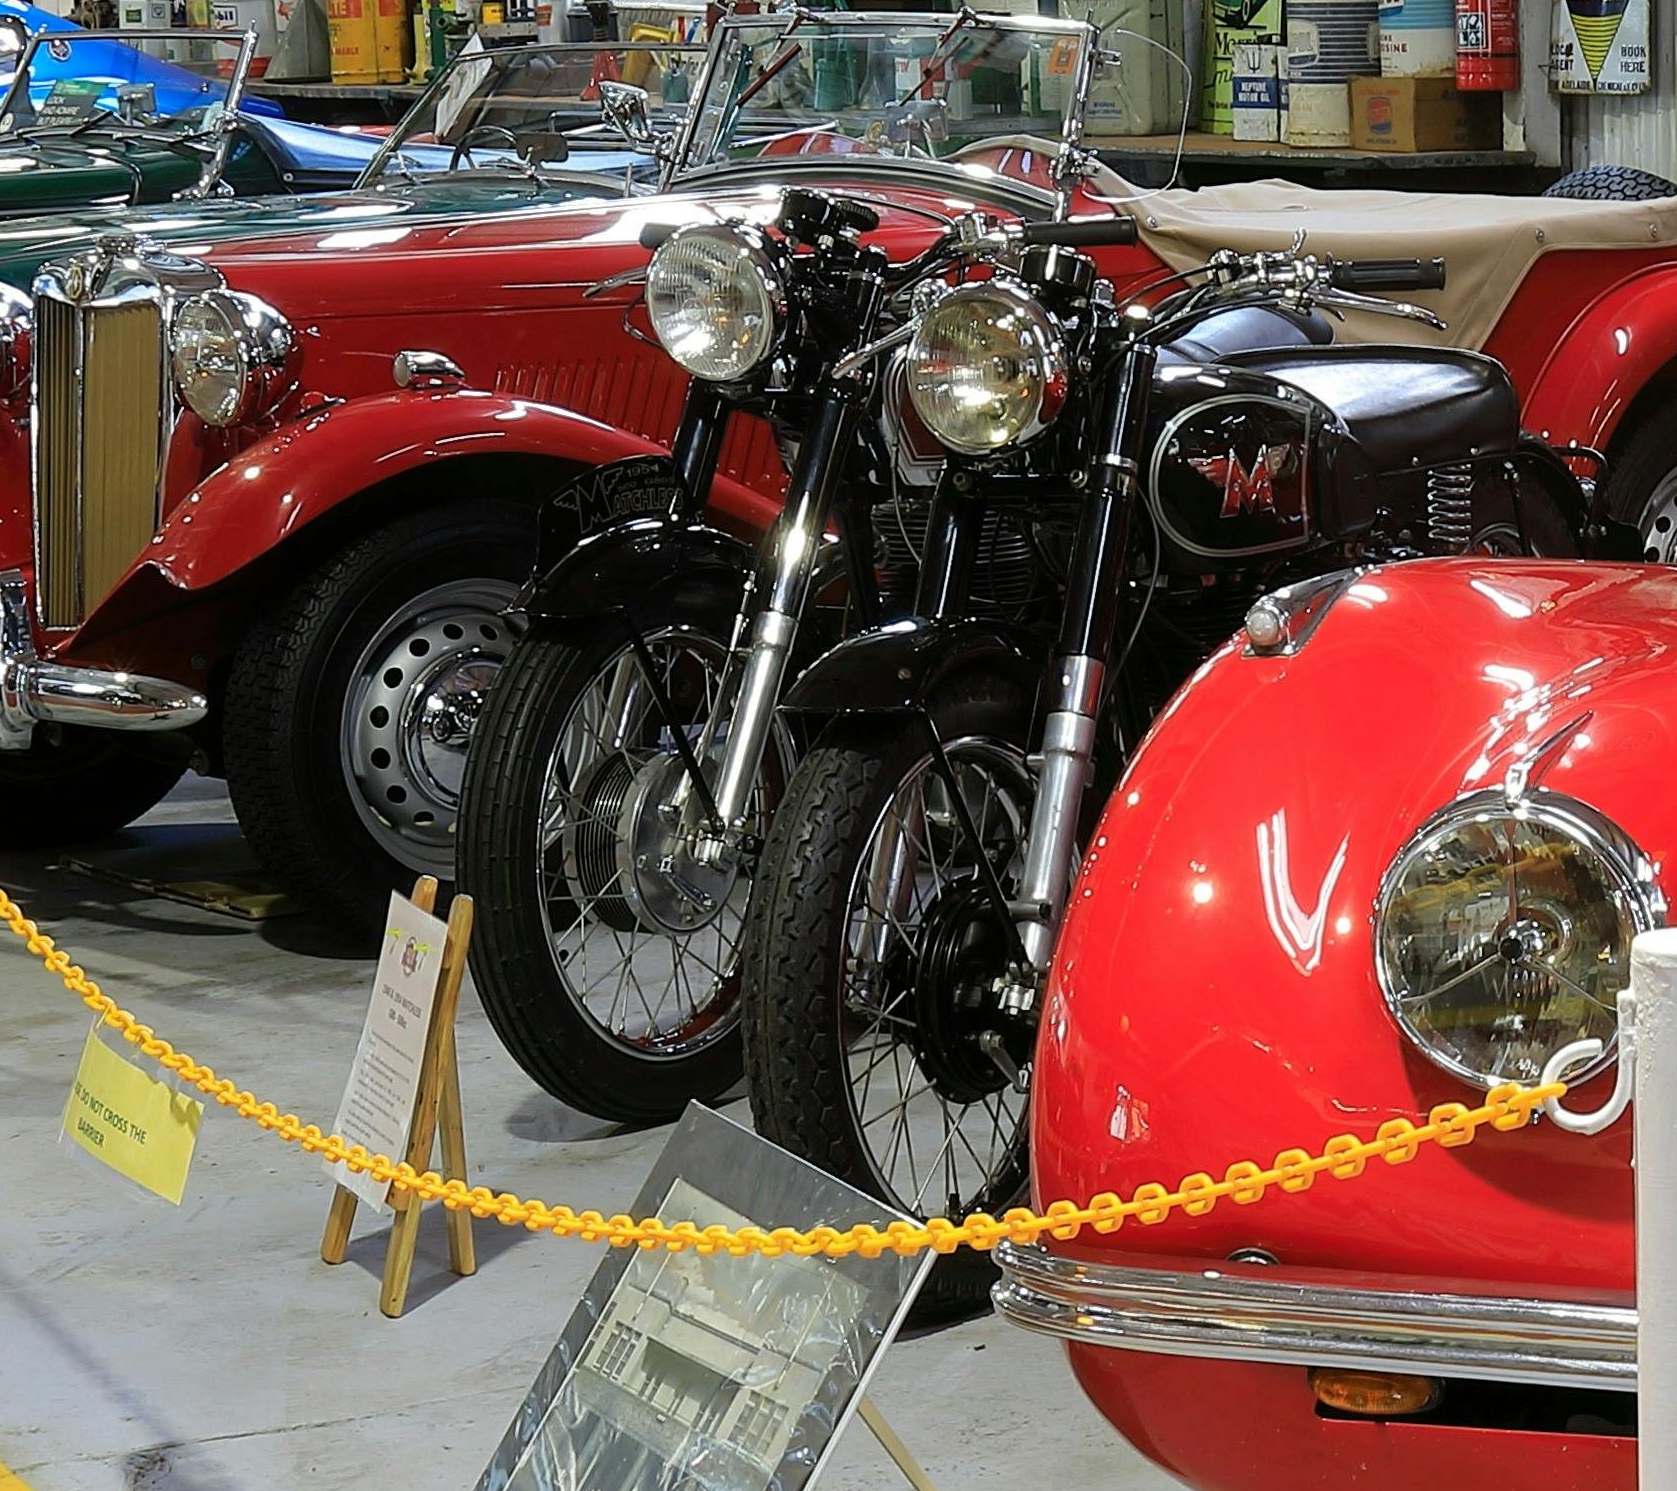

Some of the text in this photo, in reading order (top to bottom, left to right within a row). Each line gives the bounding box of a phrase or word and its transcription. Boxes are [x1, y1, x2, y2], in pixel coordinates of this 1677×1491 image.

[1621, 45, 1646, 57] BOOK
[1621, 60, 1646, 73] HERE
[79, 1087, 147, 1144] DO NOT CROSS THE
[77, 1117, 104, 1149] BARRIER
